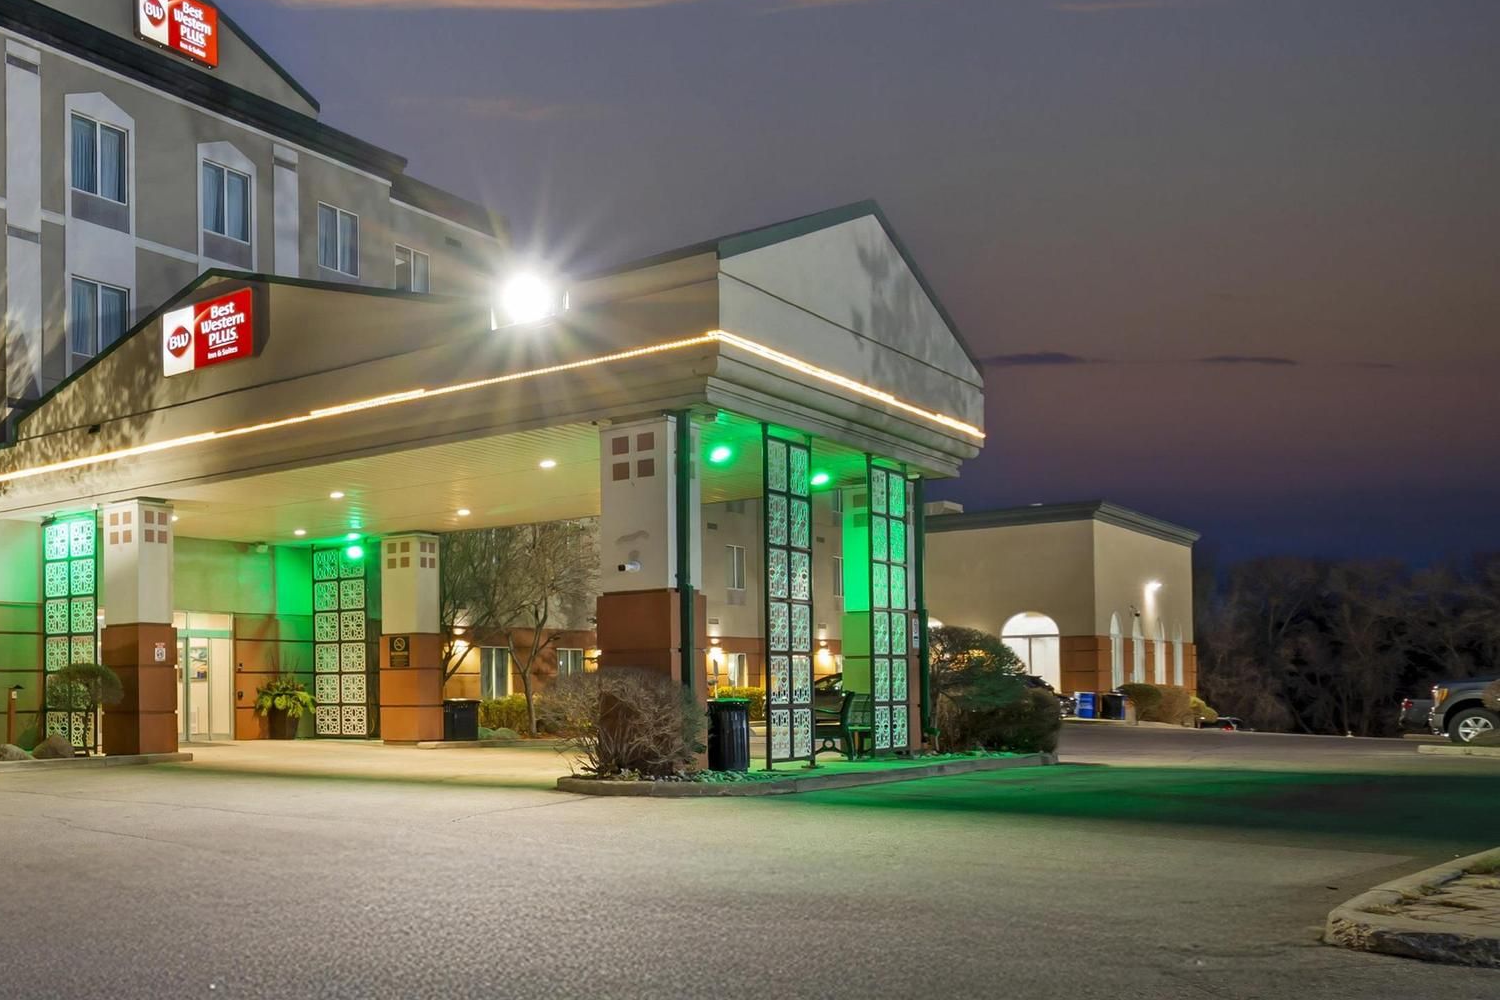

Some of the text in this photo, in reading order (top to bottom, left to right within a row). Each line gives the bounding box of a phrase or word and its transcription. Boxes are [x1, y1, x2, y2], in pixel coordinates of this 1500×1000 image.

[144, 1, 164, 20] BW
[182, 1, 204, 21] Best
[173, 8, 212, 36] Western
[180, 25, 205, 45] PLUS
[210, 302, 235, 319] Best
[200, 312, 245, 334] Western
[169, 332, 189, 350] BW
[208, 327, 237, 346] PLUS
